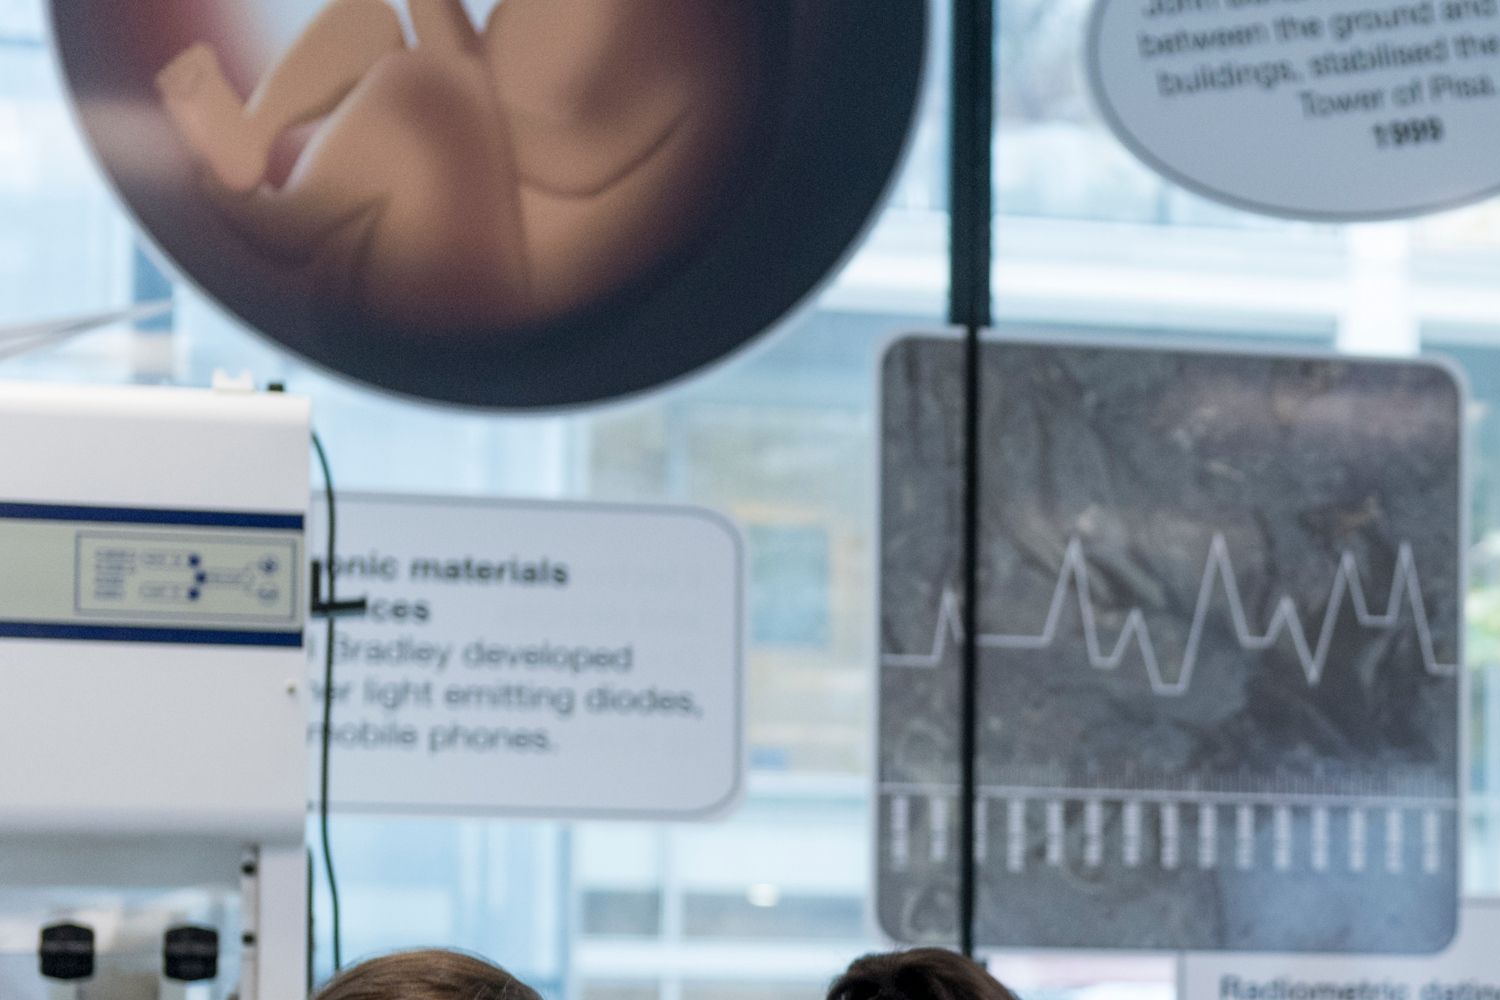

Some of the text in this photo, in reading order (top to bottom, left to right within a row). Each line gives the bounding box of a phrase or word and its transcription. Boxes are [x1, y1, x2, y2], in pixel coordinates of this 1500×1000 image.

[1136, 23, 1270, 59] between
[1272, 16, 1325, 42] the
[1326, 1, 1436, 43] ground
[1307, 36, 1449, 77] stabilised
[1297, 87, 1387, 117] Tower
[1390, 75, 1424, 107] of
[410, 554, 569, 587] materials
[332, 630, 450, 674] Bradley
[462, 636, 634, 677] developed
[361, 679, 434, 712] light
[444, 683, 575, 720] emitting
